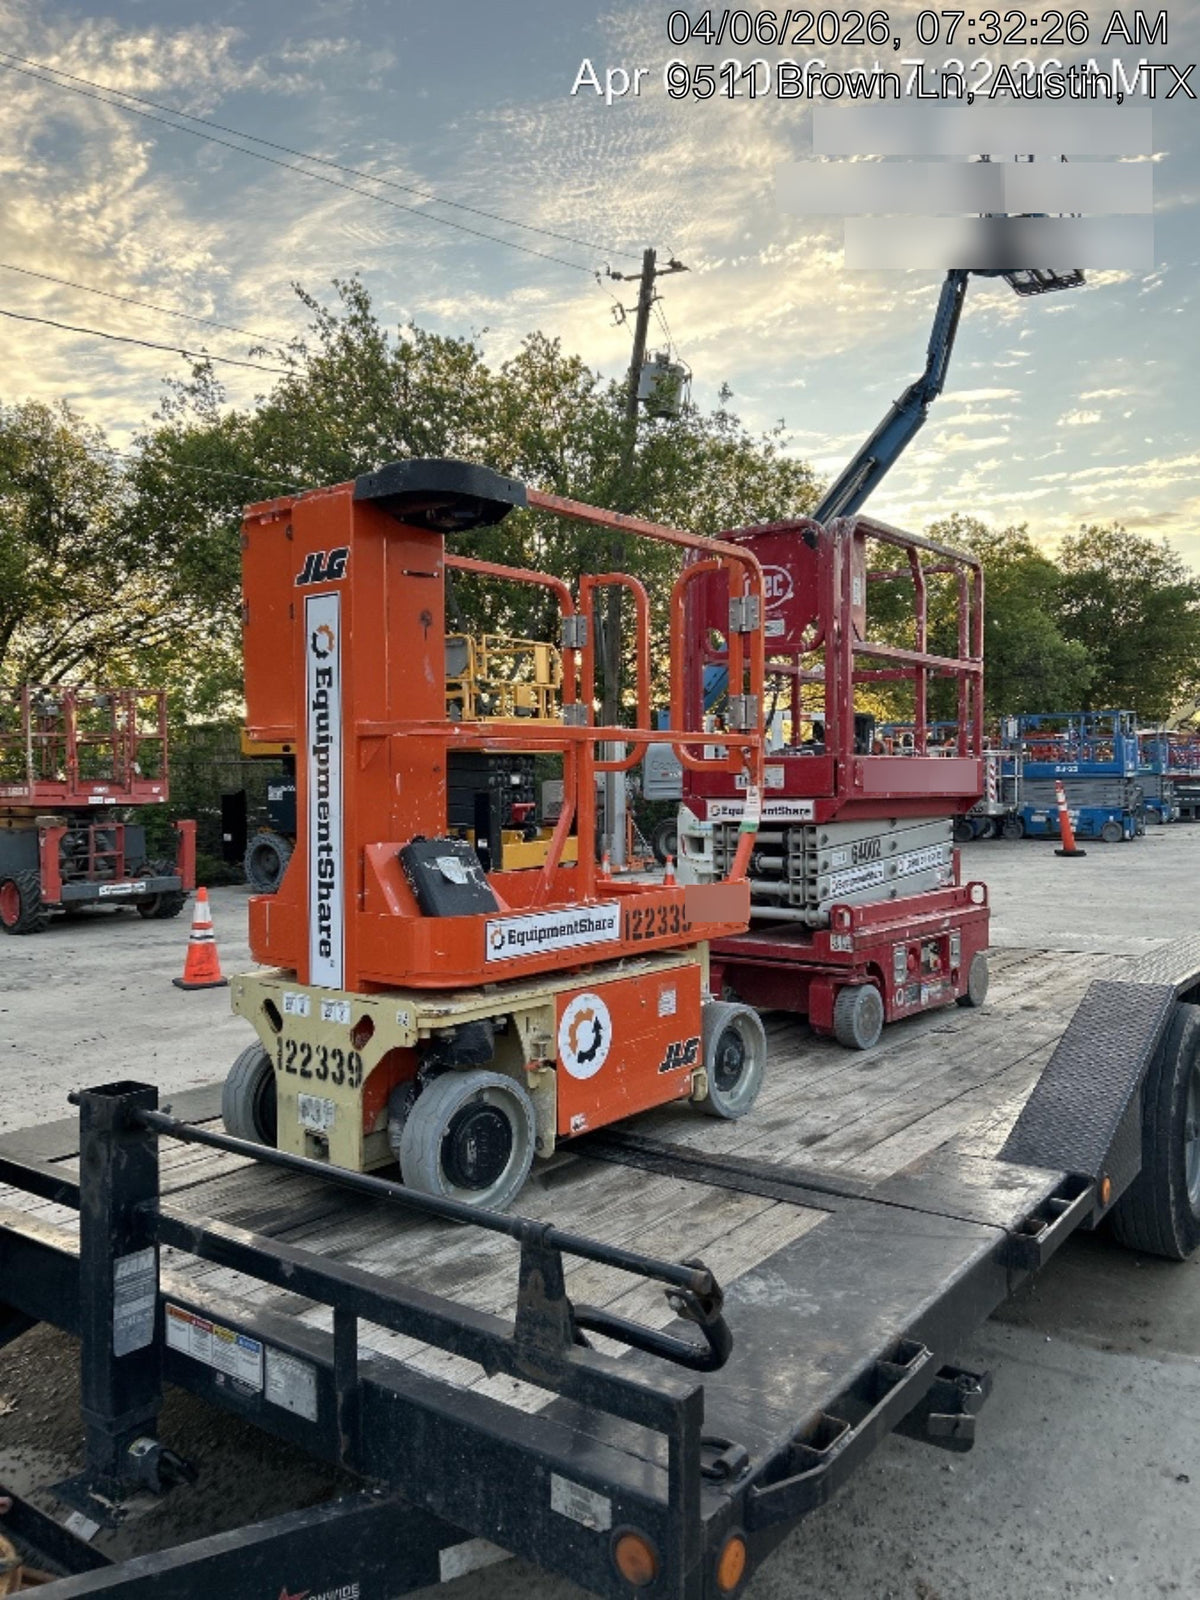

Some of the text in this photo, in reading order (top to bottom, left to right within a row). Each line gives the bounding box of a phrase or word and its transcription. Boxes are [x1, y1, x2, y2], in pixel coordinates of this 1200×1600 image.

[294, 546, 350, 587] JLG
[312, 665, 334, 959] EquipmentShare
[721, 804, 811, 816] EquientShare
[507, 917, 615, 947] EquipmentShare
[276, 1036, 364, 1089] 122339
[657, 1036, 701, 1074] JLG
